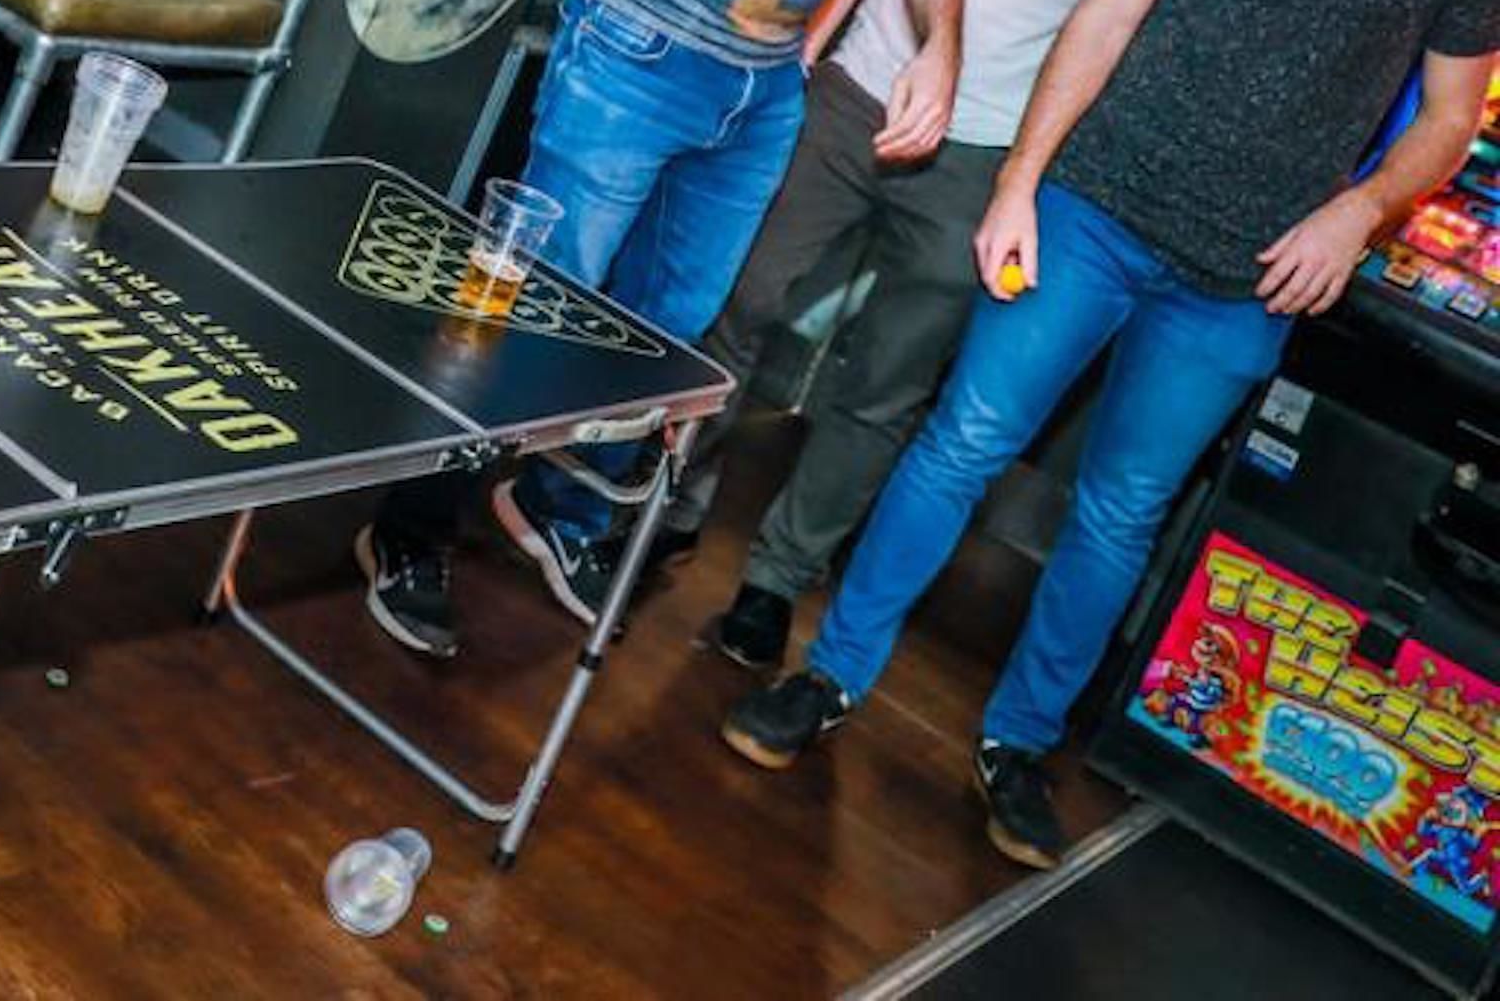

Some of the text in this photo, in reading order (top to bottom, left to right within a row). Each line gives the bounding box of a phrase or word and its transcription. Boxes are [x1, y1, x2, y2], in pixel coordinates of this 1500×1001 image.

[55, 236, 299, 391] SPIRIT DRINK
[73, 267, 244, 376] SPICED RUM
